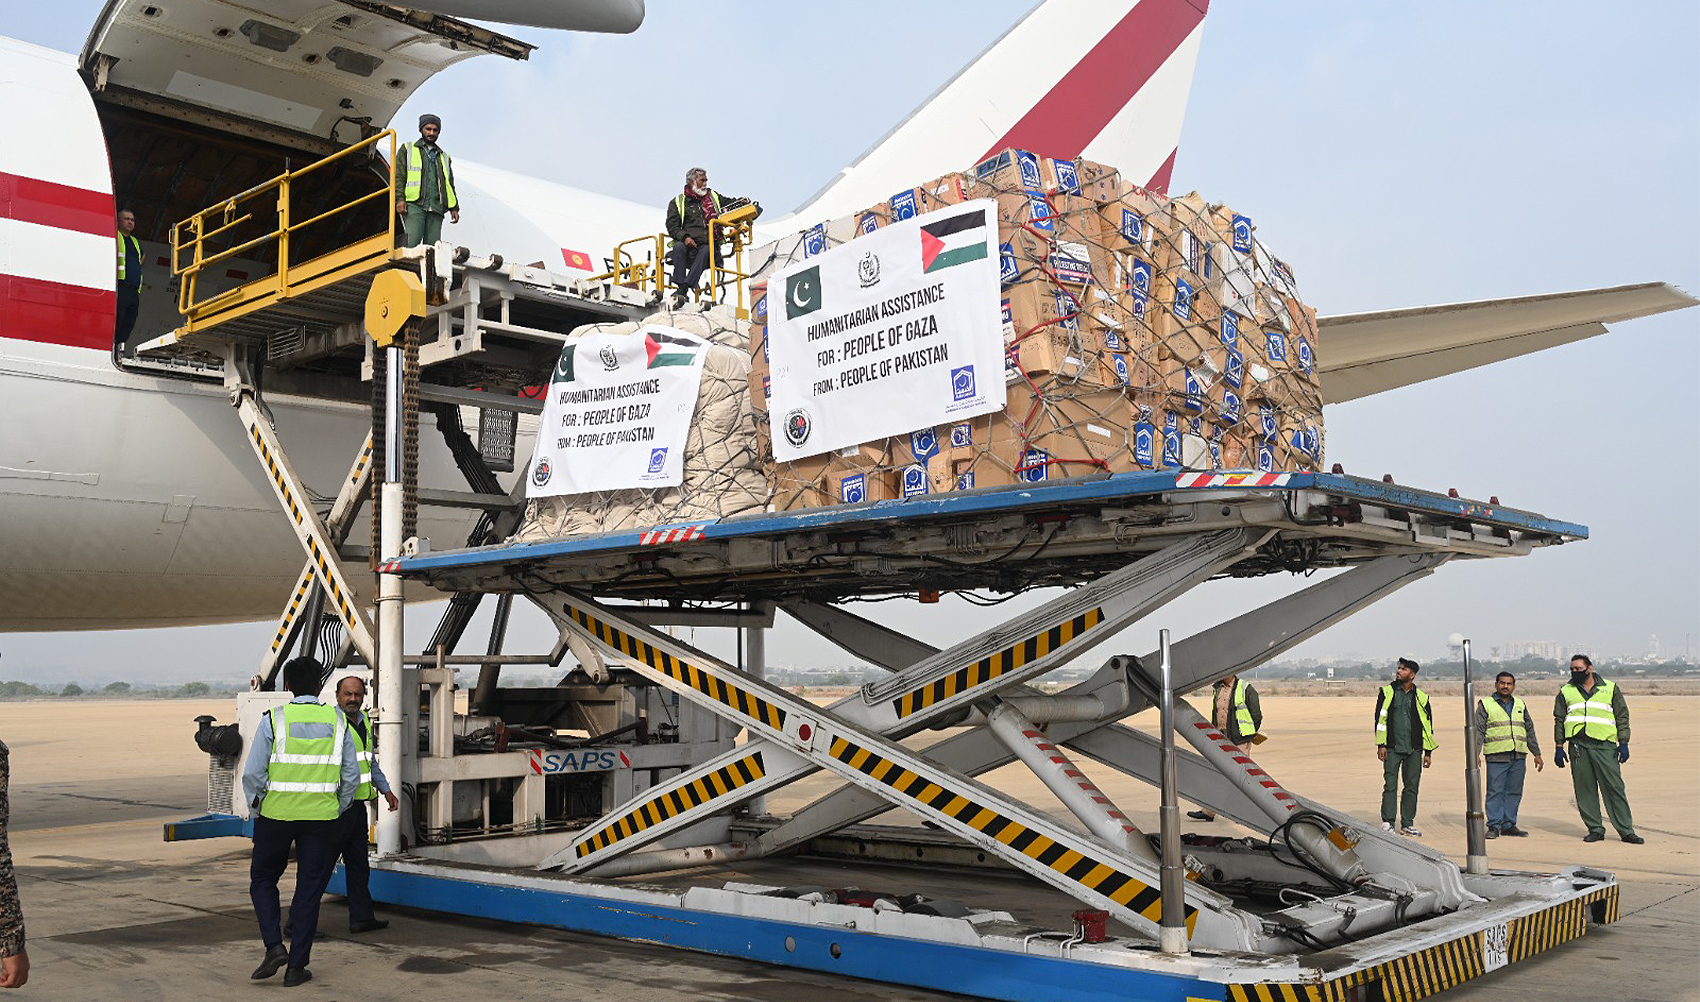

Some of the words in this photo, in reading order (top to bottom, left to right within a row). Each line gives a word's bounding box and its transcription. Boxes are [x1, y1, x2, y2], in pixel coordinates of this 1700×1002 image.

[807, 304, 880, 342] HUMANITARIAN
[881, 283, 945, 318] ASSISTANCE
[817, 349, 835, 368] FOR
[844, 330, 886, 361] PEOPLE
[888, 324, 903, 347] OF
[906, 314, 939, 342] GAZA
[813, 378, 834, 397] FROM
[840, 363, 878, 388] PEOPLE
[880, 358, 892, 378] OF
[895, 343, 949, 373] PAKISTAN
[559, 386, 616, 405] HUMANITARIAN
[616, 378, 661, 399] ASSISTANCE
[562, 413, 577, 427] FOR
[583, 408, 616, 426] PEOPLE
[616, 405, 627, 422] OF
[628, 403, 651, 421] GAZA
[577, 432, 606, 448] PEOPLE
[606, 431, 616, 446] OF
[542, 751, 616, 773] SAPS
